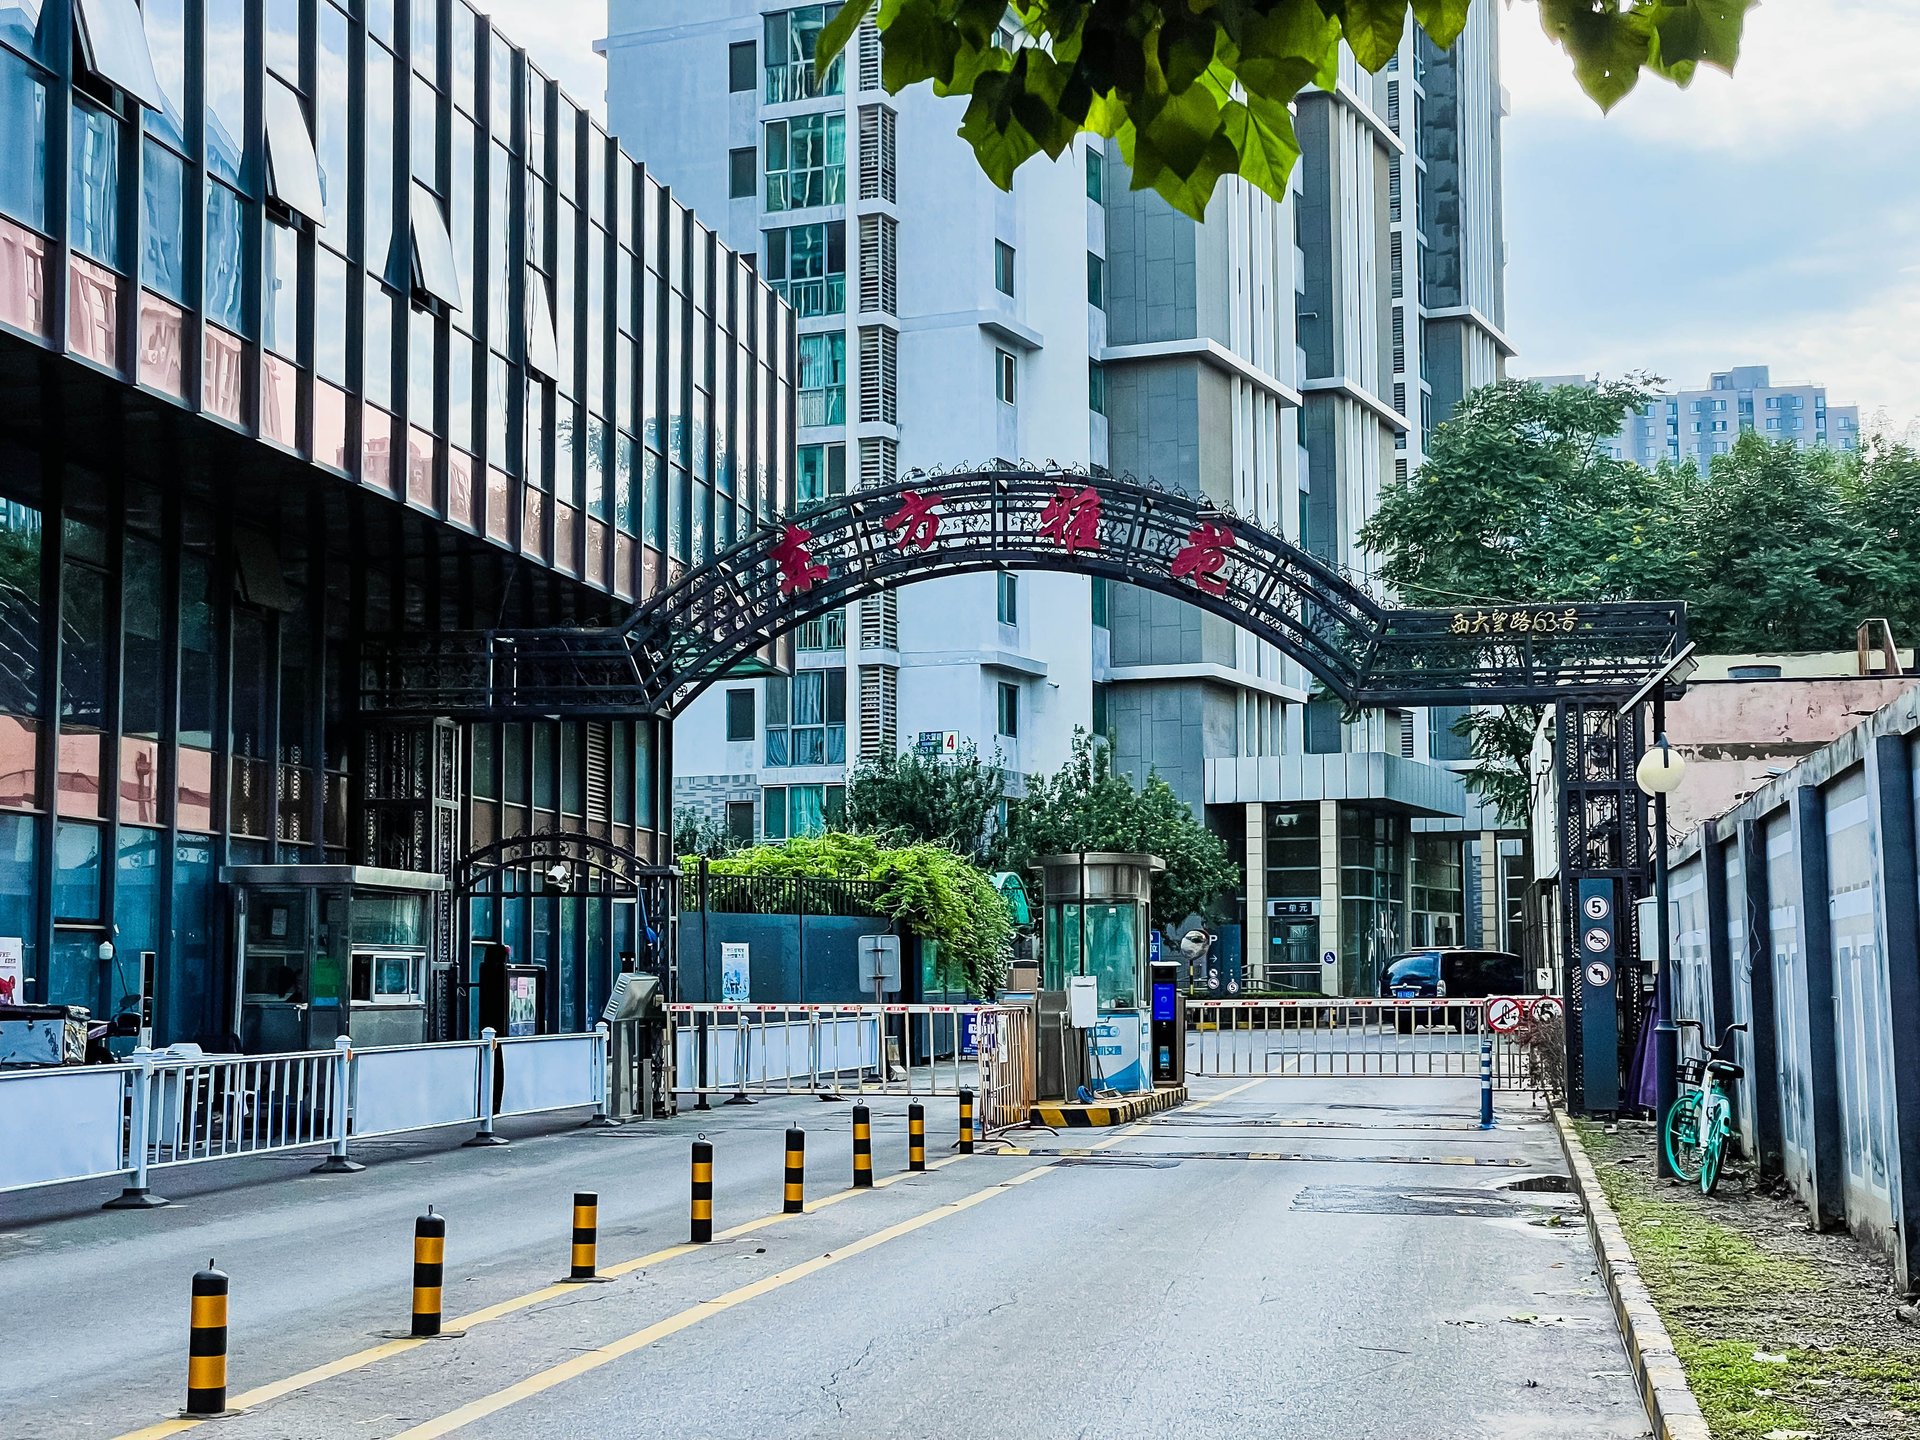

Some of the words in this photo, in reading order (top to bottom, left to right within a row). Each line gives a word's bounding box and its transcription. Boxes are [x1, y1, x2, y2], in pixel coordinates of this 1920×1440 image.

[1451, 608, 1579, 634] 西大望路63号
[946, 734, 955, 750] 4
[1277, 903, 1309, 913] 一单元
[1592, 900, 1602, 914] 5
[1209, 934, 1218, 946] P
